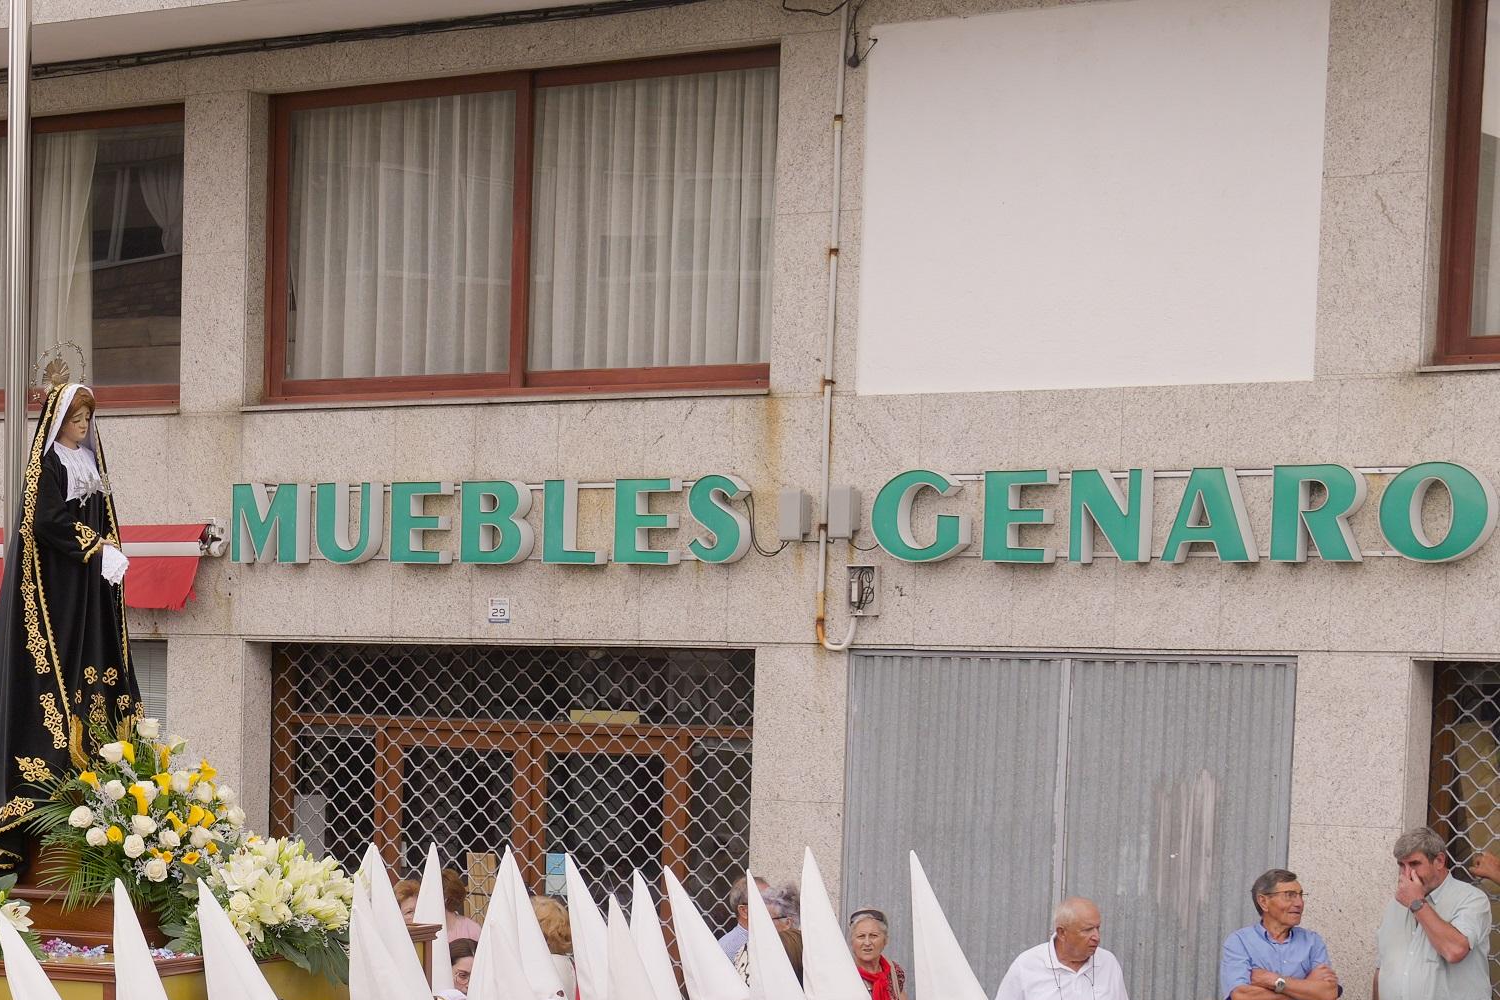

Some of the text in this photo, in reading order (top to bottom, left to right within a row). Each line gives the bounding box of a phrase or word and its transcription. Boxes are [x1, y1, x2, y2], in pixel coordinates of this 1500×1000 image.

[231, 461, 1498, 565] MUEBLES GENARO
[491, 608, 506, 617] 29
